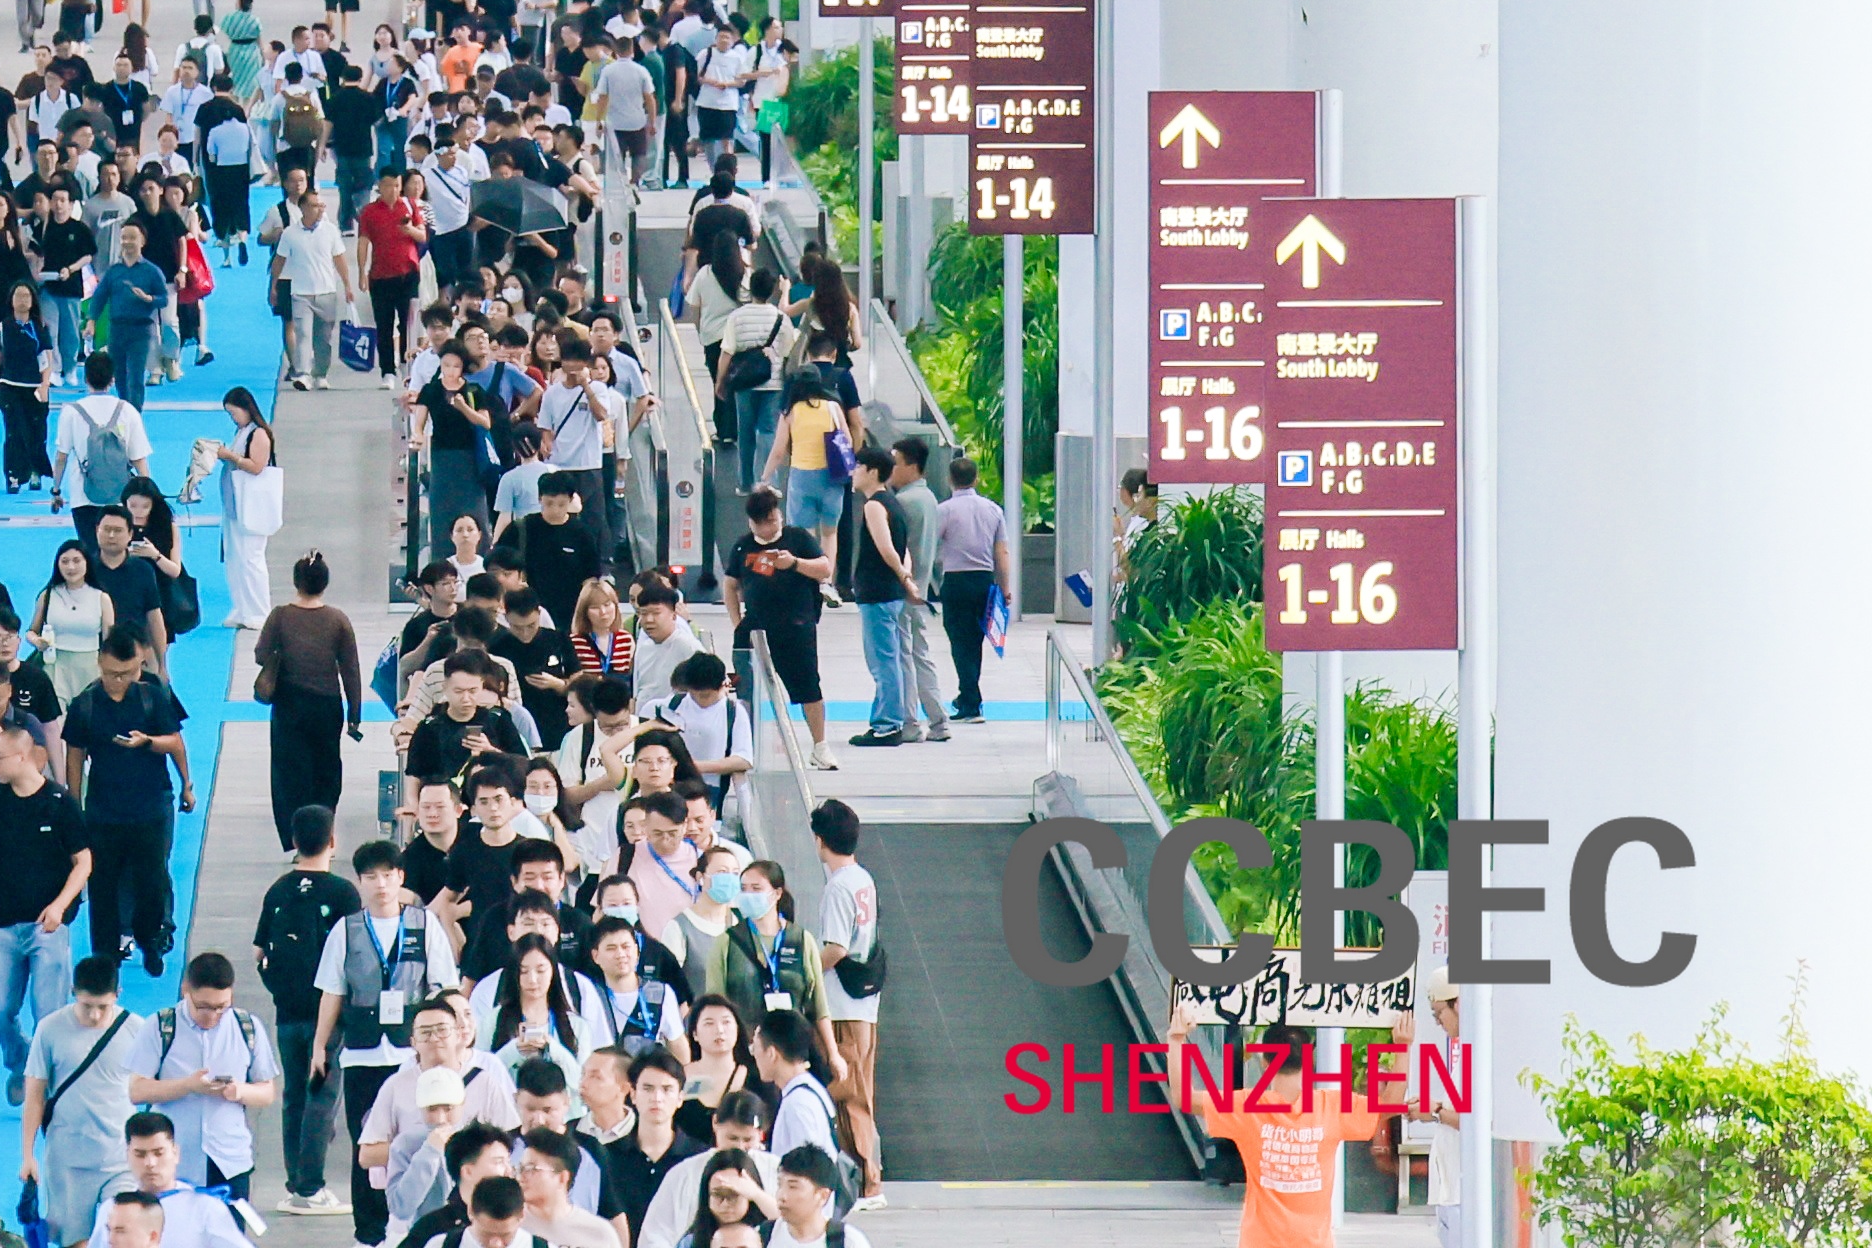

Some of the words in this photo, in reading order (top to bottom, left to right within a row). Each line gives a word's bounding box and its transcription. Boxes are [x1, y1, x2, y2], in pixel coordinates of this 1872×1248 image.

[976, 44, 1009, 59] South
[1010, 44, 1045, 61] Lobby
[901, 84, 971, 123] 1-14
[976, 177, 1055, 220] 1-14
[1160, 229, 1203, 247] South
[1204, 229, 1249, 250] Lobby
[1277, 333, 1378, 356] 南登录大厅
[1277, 358, 1326, 378] South
[1328, 358, 1379, 382] Lobby
[1160, 377, 1197, 397] 展厅
[1202, 377, 1235, 395] Halls
[1160, 405, 1264, 461] 1-16
[1285, 457, 1305, 481] P
[1278, 530, 1318, 551] 展厅
[1326, 530, 1365, 549] Halls
[1278, 560, 1397, 625] 1-16
